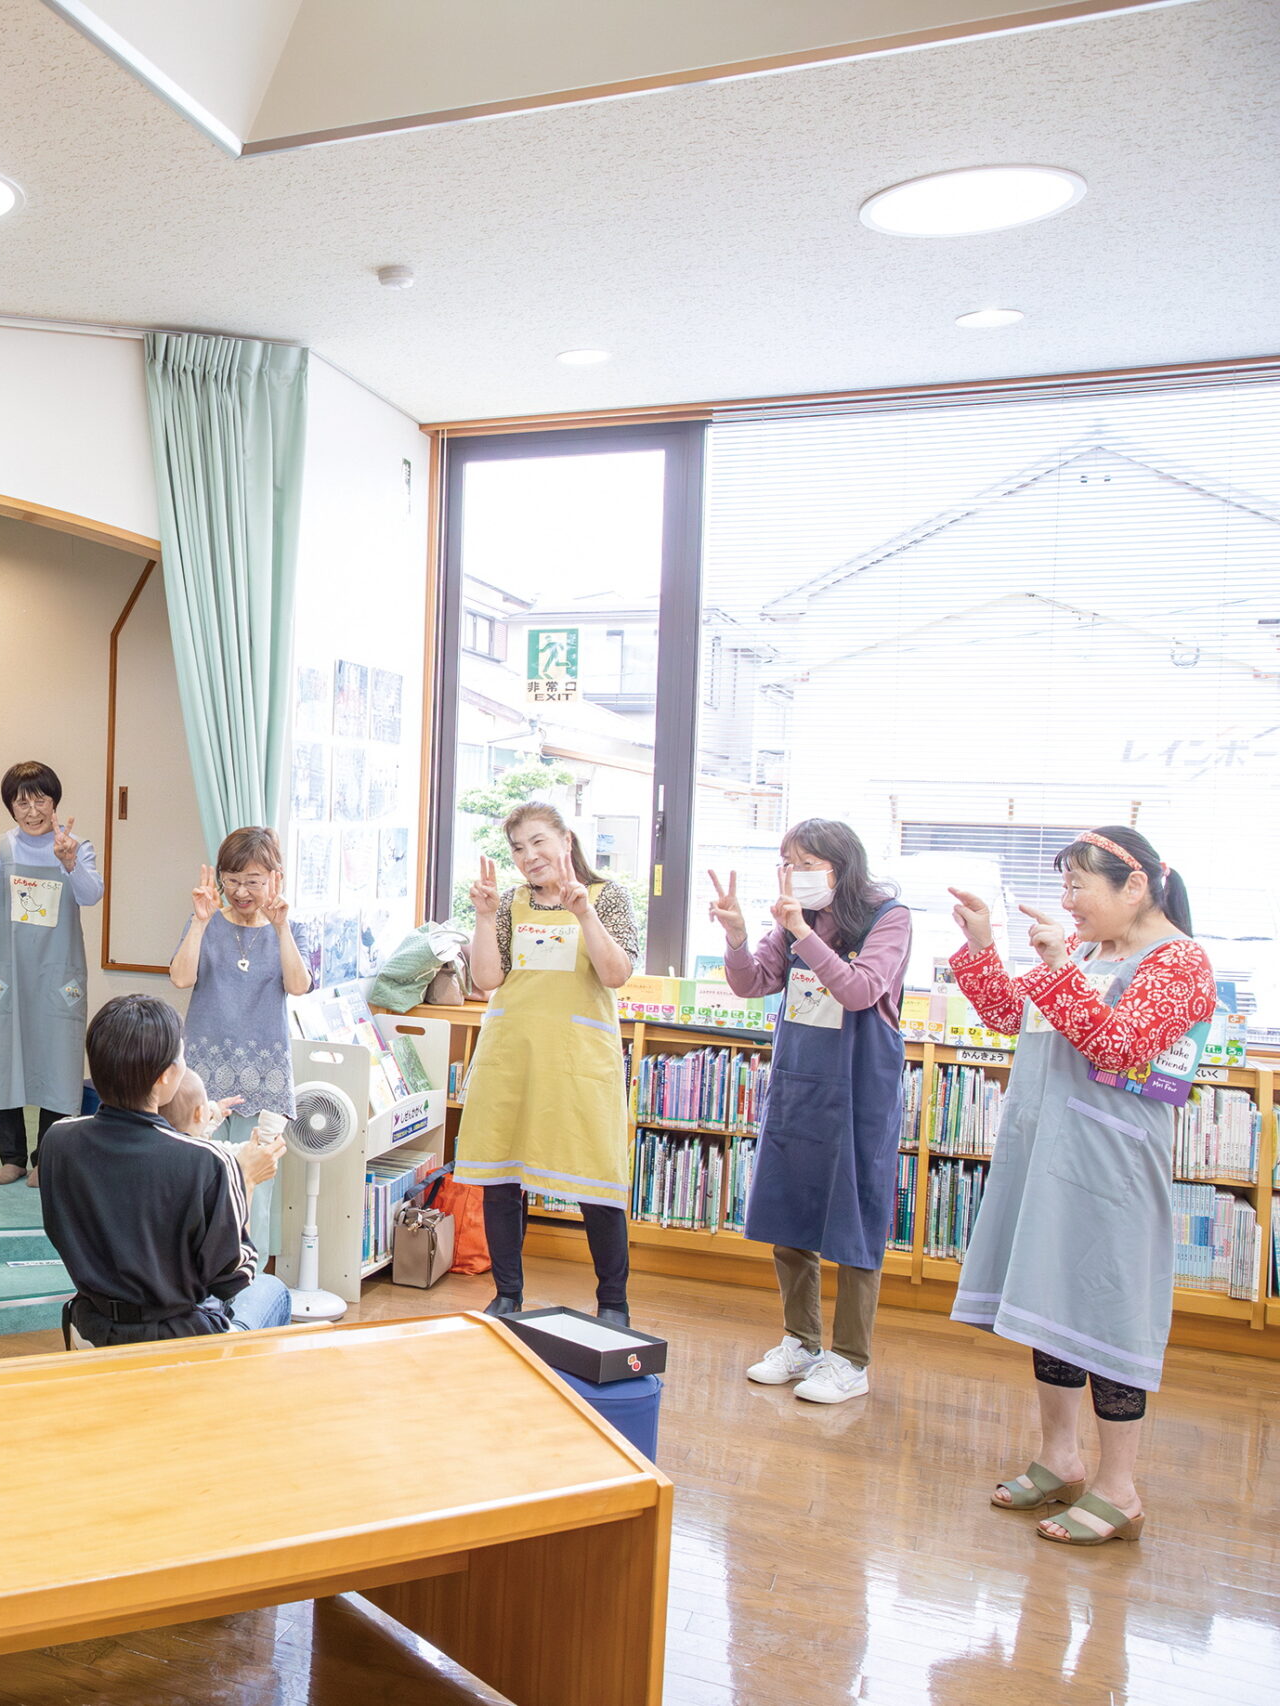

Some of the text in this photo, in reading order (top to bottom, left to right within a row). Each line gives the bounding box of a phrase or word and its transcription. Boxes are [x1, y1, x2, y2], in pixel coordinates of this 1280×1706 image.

[527, 681, 577, 692] 非常口
[534, 693, 573, 701] EXIT
[962, 1050, 1004, 1062] かんきょう
